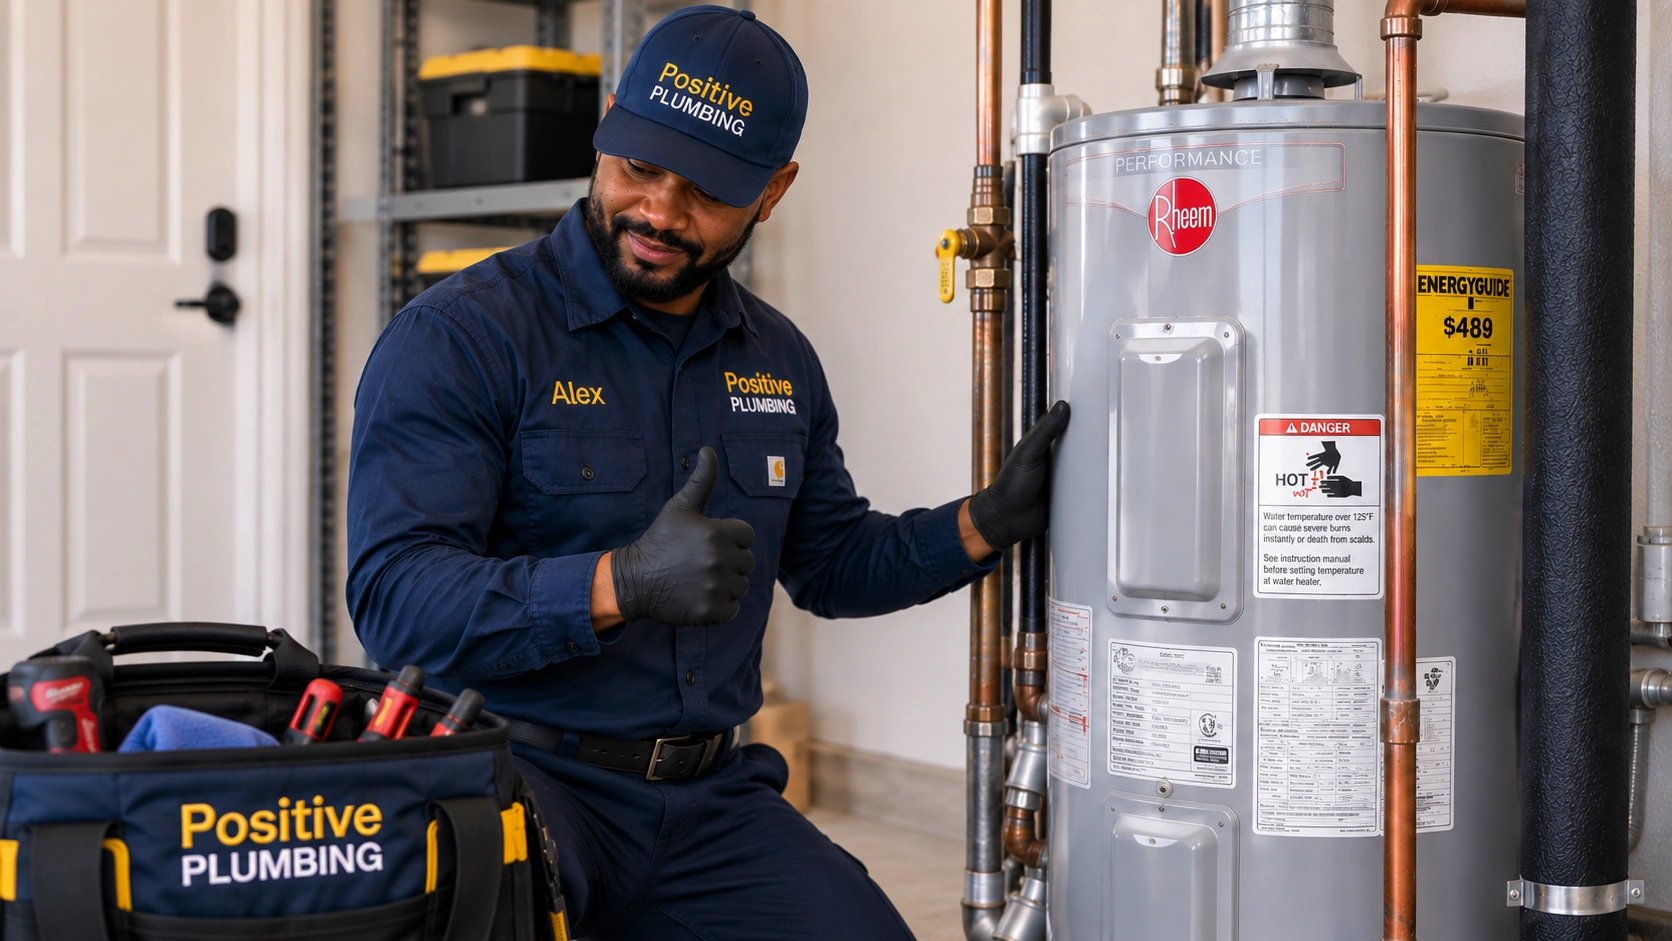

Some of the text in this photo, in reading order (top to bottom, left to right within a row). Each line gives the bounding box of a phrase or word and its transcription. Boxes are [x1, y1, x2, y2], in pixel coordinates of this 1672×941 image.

[658, 62, 754, 117] Positive
[649, 85, 746, 137] PLUMBING
[1115, 150, 1262, 173] PERFORMANCE
[1154, 180, 1213, 248] Rheem
[1417, 275, 1510, 297] ENERGYGUIDE
[1443, 315, 1493, 339] $489
[551, 380, 606, 405] Alex
[724, 371, 793, 396] Positive
[730, 396, 797, 415] PLUMBING
[1300, 422, 1351, 433] DANGER
[1275, 473, 1309, 487] HOT
[1263, 512, 1286, 521] Water
[1287, 512, 1334, 522] temperature
[1335, 513, 1351, 521] over
[1263, 524, 1278, 532] can
[1279, 524, 1302, 532] cause
[1329, 523, 1351, 532] burns
[1263, 534, 1296, 545] instantly
[1307, 535, 1329, 543] death
[1330, 535, 1348, 543] from
[1349, 535, 1376, 544] scalds.
[1263, 553, 1351, 563] See instruction manual
[1263, 565, 1365, 576] before setting temperature
[1263, 577, 1322, 586] at water heater.
[180, 795, 383, 849] Positive
[181, 841, 384, 887] PLUMBING
